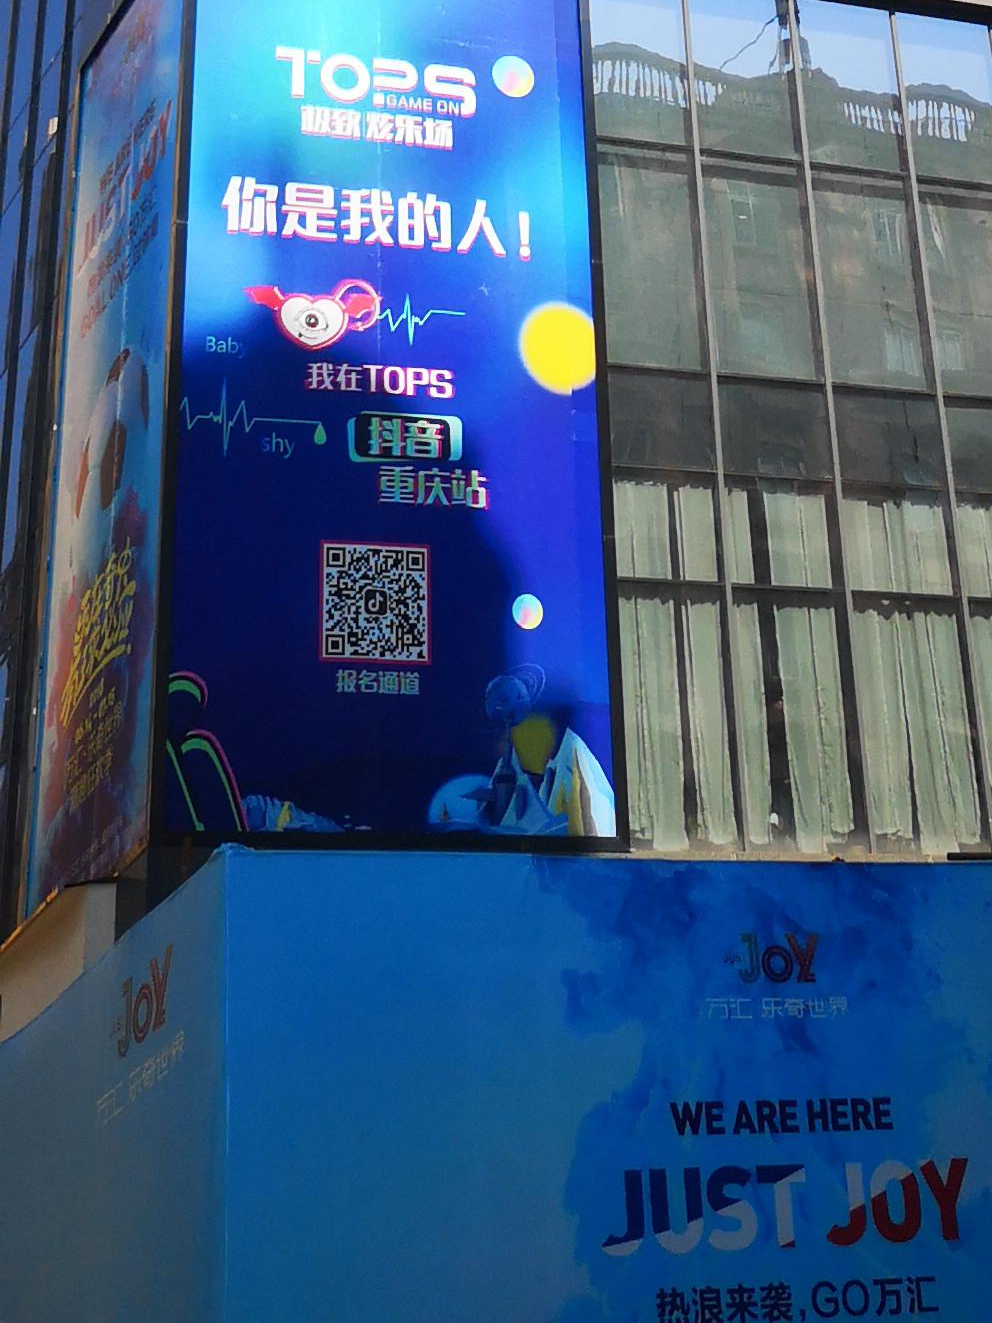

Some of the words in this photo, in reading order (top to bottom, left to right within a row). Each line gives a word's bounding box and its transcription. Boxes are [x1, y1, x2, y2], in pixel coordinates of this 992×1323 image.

[275, 45, 477, 118] TOPS
[386, 93, 433, 114] GAME
[436, 99, 462, 117] ON
[304, 362, 455, 399] 我在TOPS
[368, 416, 444, 458] 抖音
[379, 465, 489, 510] 重庆站
[335, 668, 421, 695] 报名通道
[669, 1100, 726, 1136] WE
[732, 1099, 800, 1135] ARE
[806, 1096, 894, 1133] HERE
[601, 1163, 807, 1256] JUST
[826, 1157, 969, 1247] JOY
